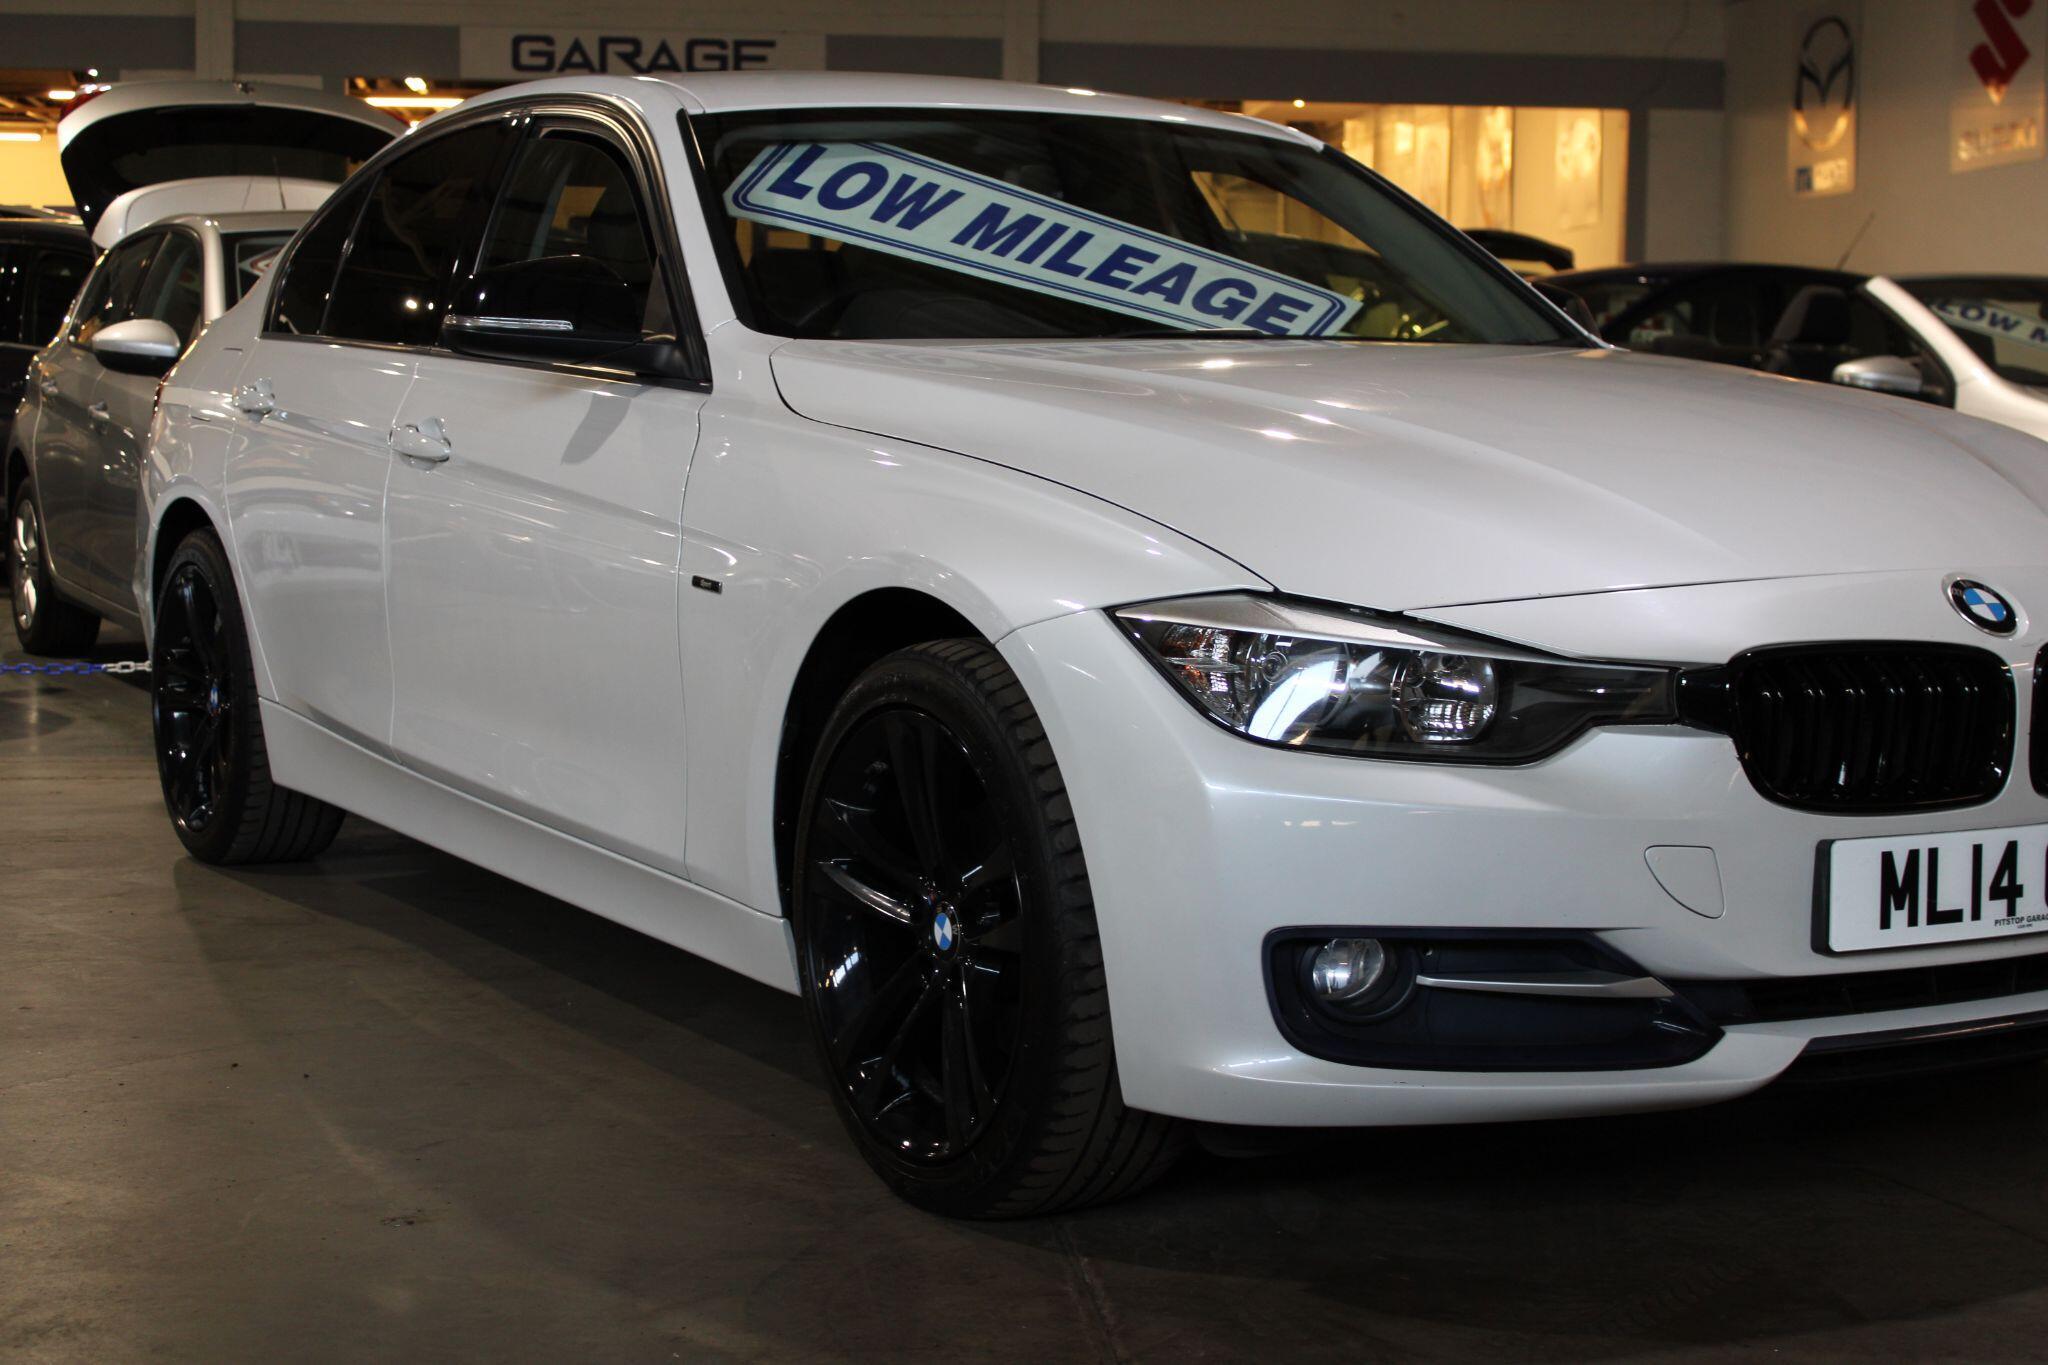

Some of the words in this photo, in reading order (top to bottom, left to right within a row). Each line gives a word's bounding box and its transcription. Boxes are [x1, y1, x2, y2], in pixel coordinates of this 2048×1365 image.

[511, 35, 776, 73] GARAGE
[766, 143, 966, 231] LOW
[950, 202, 1315, 336] MILEAGE
[1879, 840, 2024, 930] ML14
[1994, 916, 2025, 927] PITSTOP
